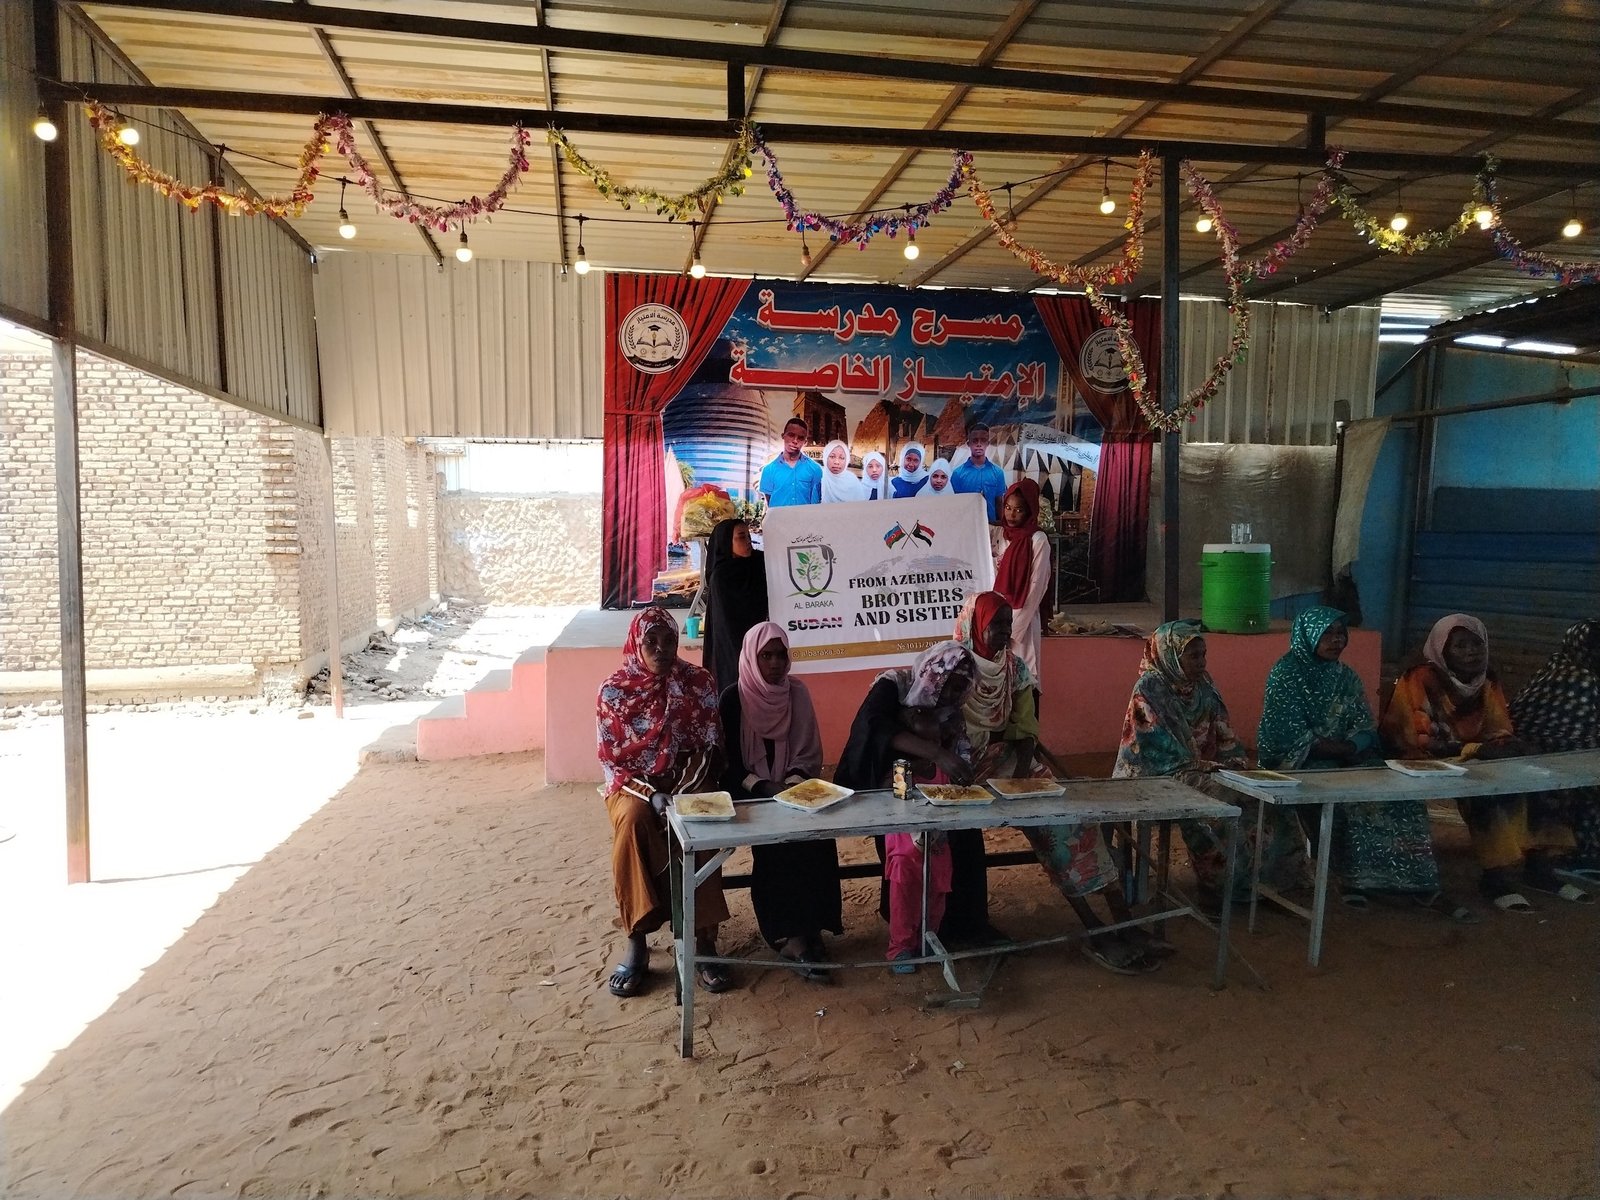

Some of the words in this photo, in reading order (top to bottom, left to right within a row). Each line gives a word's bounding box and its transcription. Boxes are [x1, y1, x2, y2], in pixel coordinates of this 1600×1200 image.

[657, 314, 676, 326] مدرسة
[757, 289, 901, 341] مدرسة
[912, 307, 1025, 345] مسرح
[729, 347, 891, 393] الخاصة
[897, 354, 1046, 409] الإمتياز
[849, 576, 886, 589] FROM
[890, 569, 973, 586] AZERBAIJAN
[805, 600, 834, 608] BARAKA
[861, 587, 964, 608] BROTHERS
[788, 617, 842, 631] SUDAN
[854, 610, 891, 627] AND
[896, 604, 964, 624] SISTER
